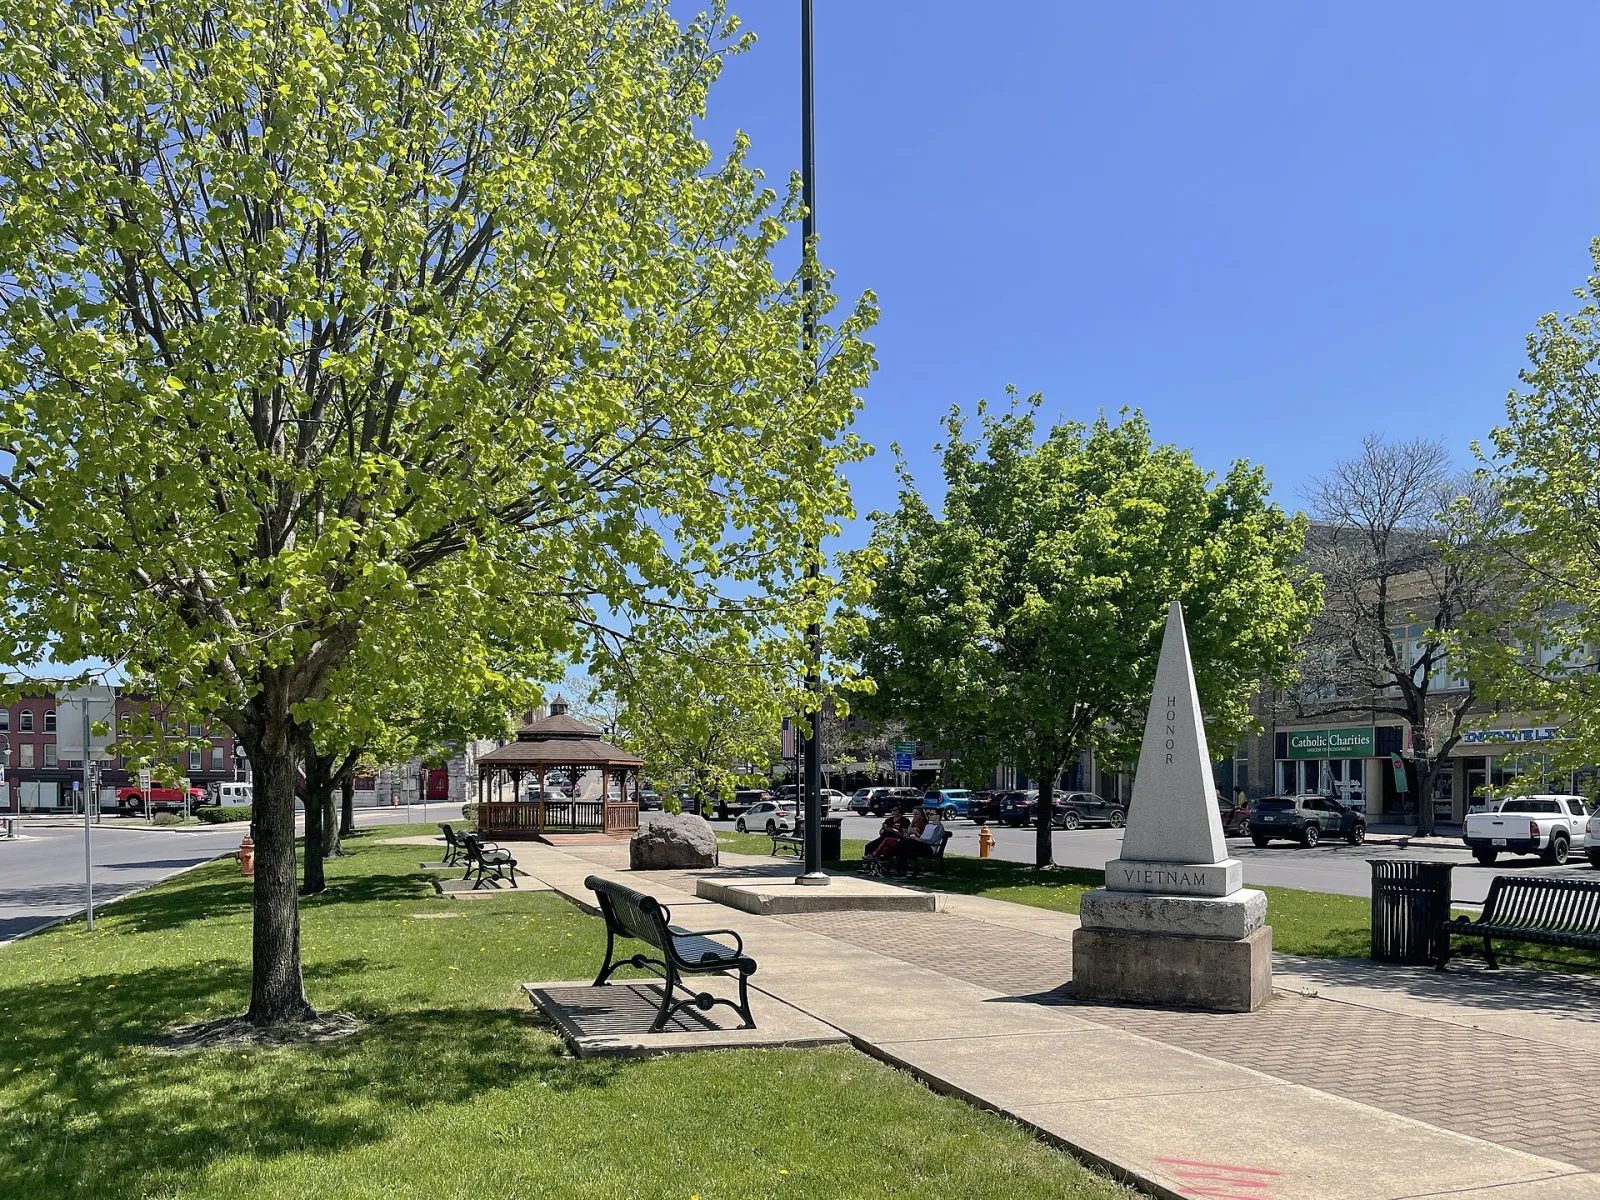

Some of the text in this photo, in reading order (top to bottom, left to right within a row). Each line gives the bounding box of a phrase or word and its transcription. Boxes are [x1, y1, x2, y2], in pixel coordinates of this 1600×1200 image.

[1166, 696, 1176, 764] HONOR
[1292, 734, 1370, 748] Catholic Charities
[1124, 869, 1206, 886] VIETNAM
